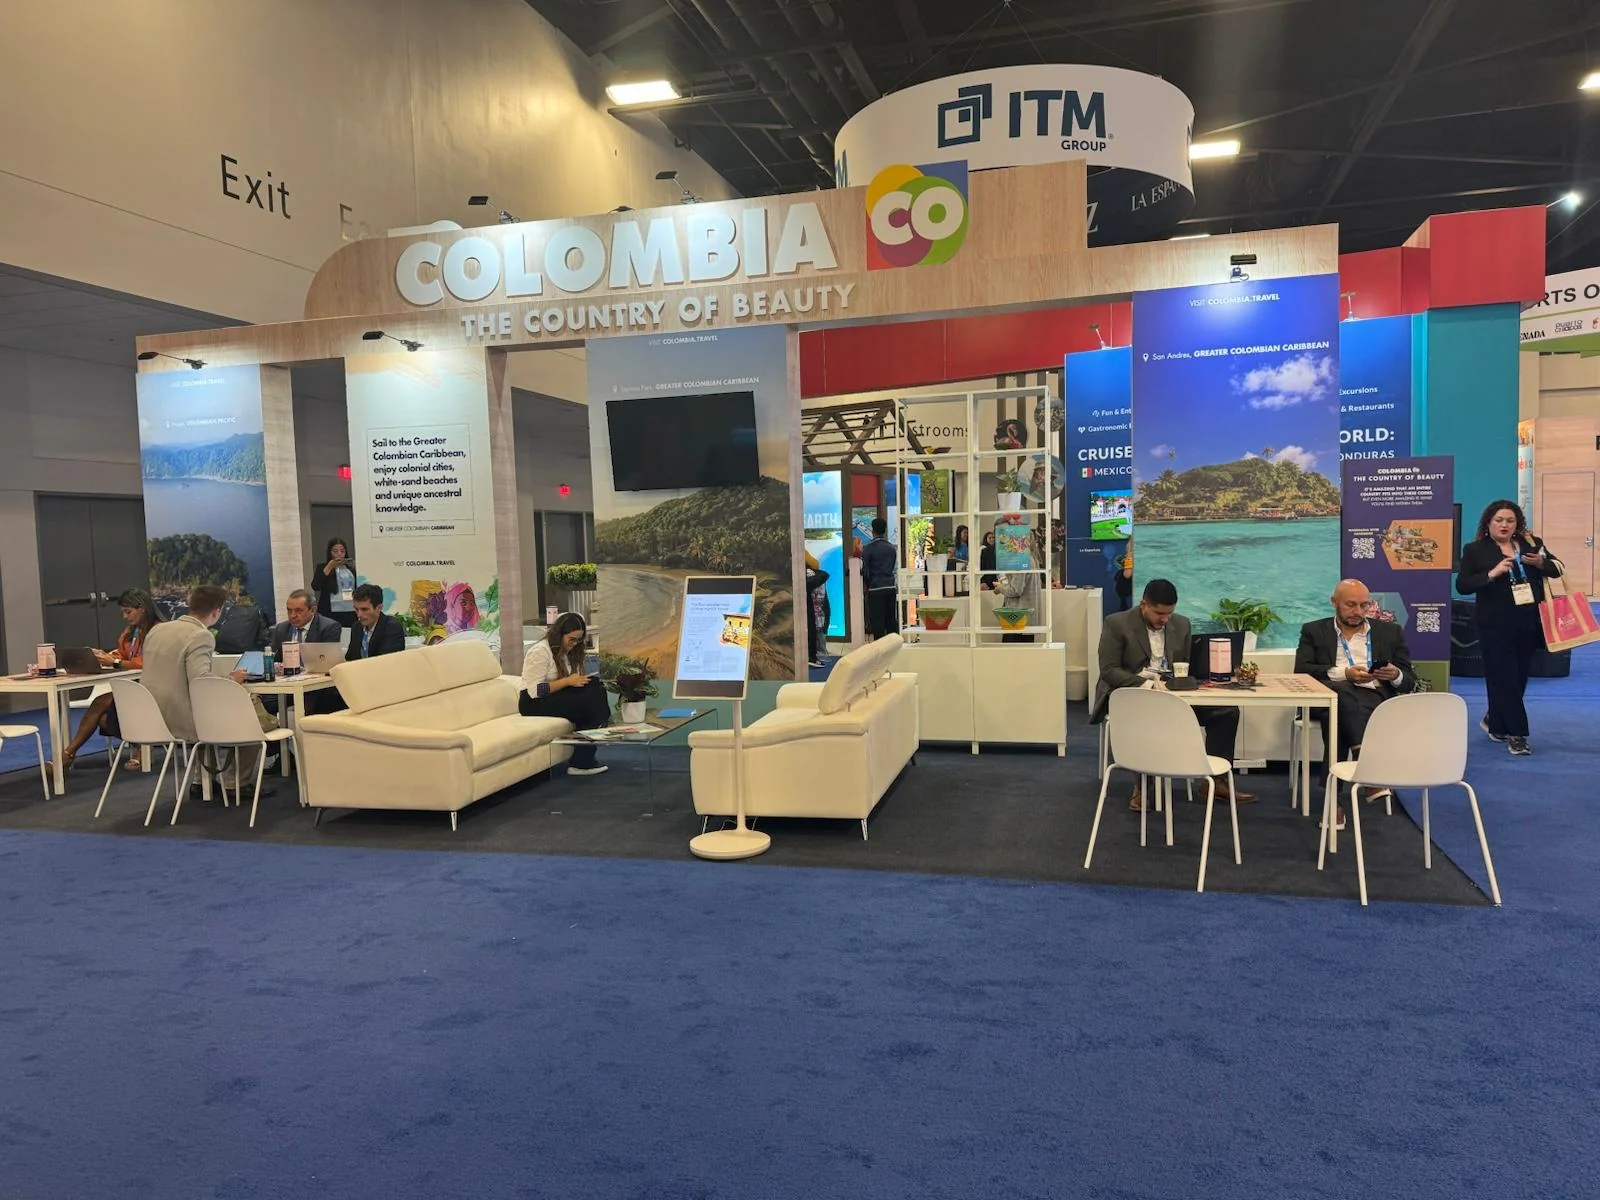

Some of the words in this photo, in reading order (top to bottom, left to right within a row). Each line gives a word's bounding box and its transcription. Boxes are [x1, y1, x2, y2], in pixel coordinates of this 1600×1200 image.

[1009, 91, 1106, 138] ITM
[1061, 140, 1106, 151] GROUP
[221, 154, 291, 219] Exit
[1131, 193, 1147, 211] LA
[870, 191, 964, 246] CO
[395, 202, 838, 306] COLOMBIA
[1189, 299, 1206, 307] VISIT
[1208, 293, 1280, 306] COLOMBIA.TRAVEL
[461, 311, 511, 338] THE
[523, 301, 666, 334] COUNTRY
[678, 295, 718, 322] OF
[734, 283, 856, 318] BEAUTY
[662, 335, 718, 345] COLOMBIA.TRAVEL
[1152, 353, 1166, 361] San
[1167, 351, 1192, 360] Andres,
[1193, 349, 1229, 358] GREATER
[1230, 345, 1281, 355] COLOMBIAN
[1282, 341, 1330, 351] CARIBBEAN
[655, 382, 682, 390] GREATER
[683, 379, 722, 388] COLOMBIAN
[723, 376, 760, 386] CARIBBEAN
[1348, 402, 1395, 412] Restaurants
[1088, 423, 1128, 432] Gastronomic
[372, 438, 388, 448] Sail
[389, 439, 397, 447] to
[399, 437, 412, 446] the
[413, 437, 447, 446] Greater
[373, 450, 418, 461] Colombian
[419, 448, 466, 459] Caribbean,
[1078, 446, 1133, 461] CRUISE
[373, 465, 397, 476] enjoy
[399, 463, 431, 473] colonial
[432, 462, 455, 473] cities,
[374, 476, 422, 487] white-sand
[423, 475, 458, 485] beaches
[375, 490, 392, 500] and
[393, 490, 422, 501] unique
[423, 488, 462, 498] ancestral
[375, 502, 427, 514] knowledge.
[405, 559, 456, 567] COLOMBIA.TRAVEL
